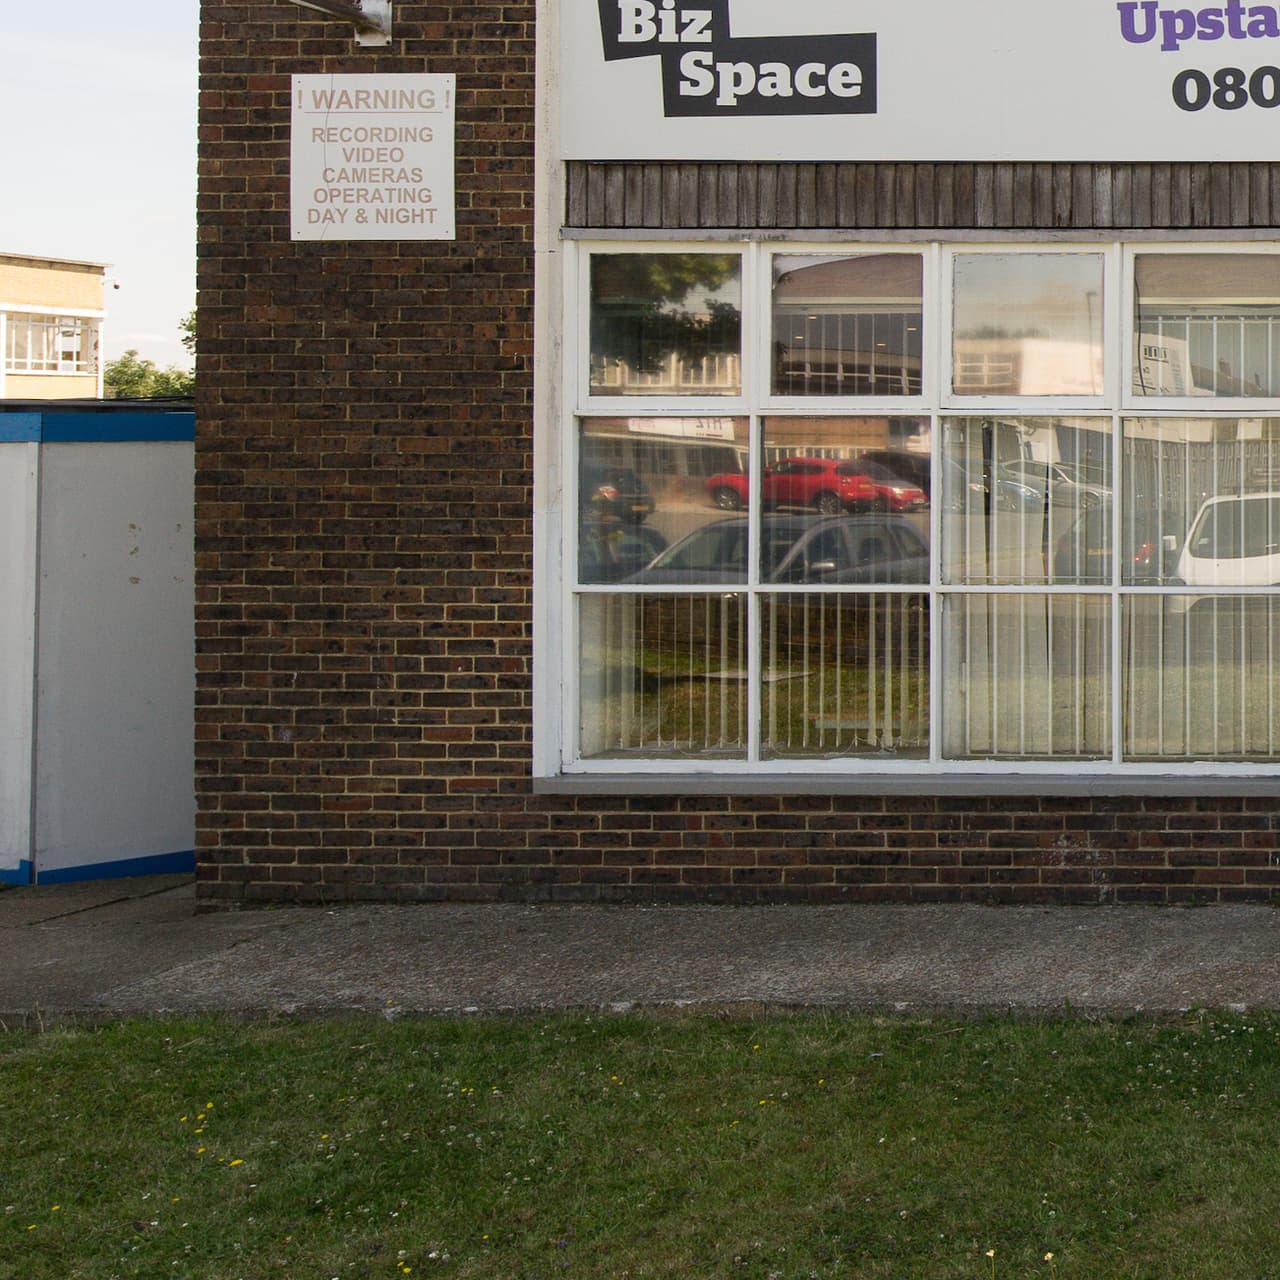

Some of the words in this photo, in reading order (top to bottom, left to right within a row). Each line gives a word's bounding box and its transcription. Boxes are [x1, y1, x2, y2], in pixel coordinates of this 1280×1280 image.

[679, 50, 863, 106] Space
[312, 89, 436, 110] WARNING
[312, 127, 433, 143] RECORDING
[342, 147, 404, 163] VIDEO
[322, 168, 423, 184] CAMERAS
[314, 188, 432, 204] OPERATING
[308, 208, 349, 224] DAY
[355, 208, 368, 224] &
[376, 208, 438, 224] NIGHT
